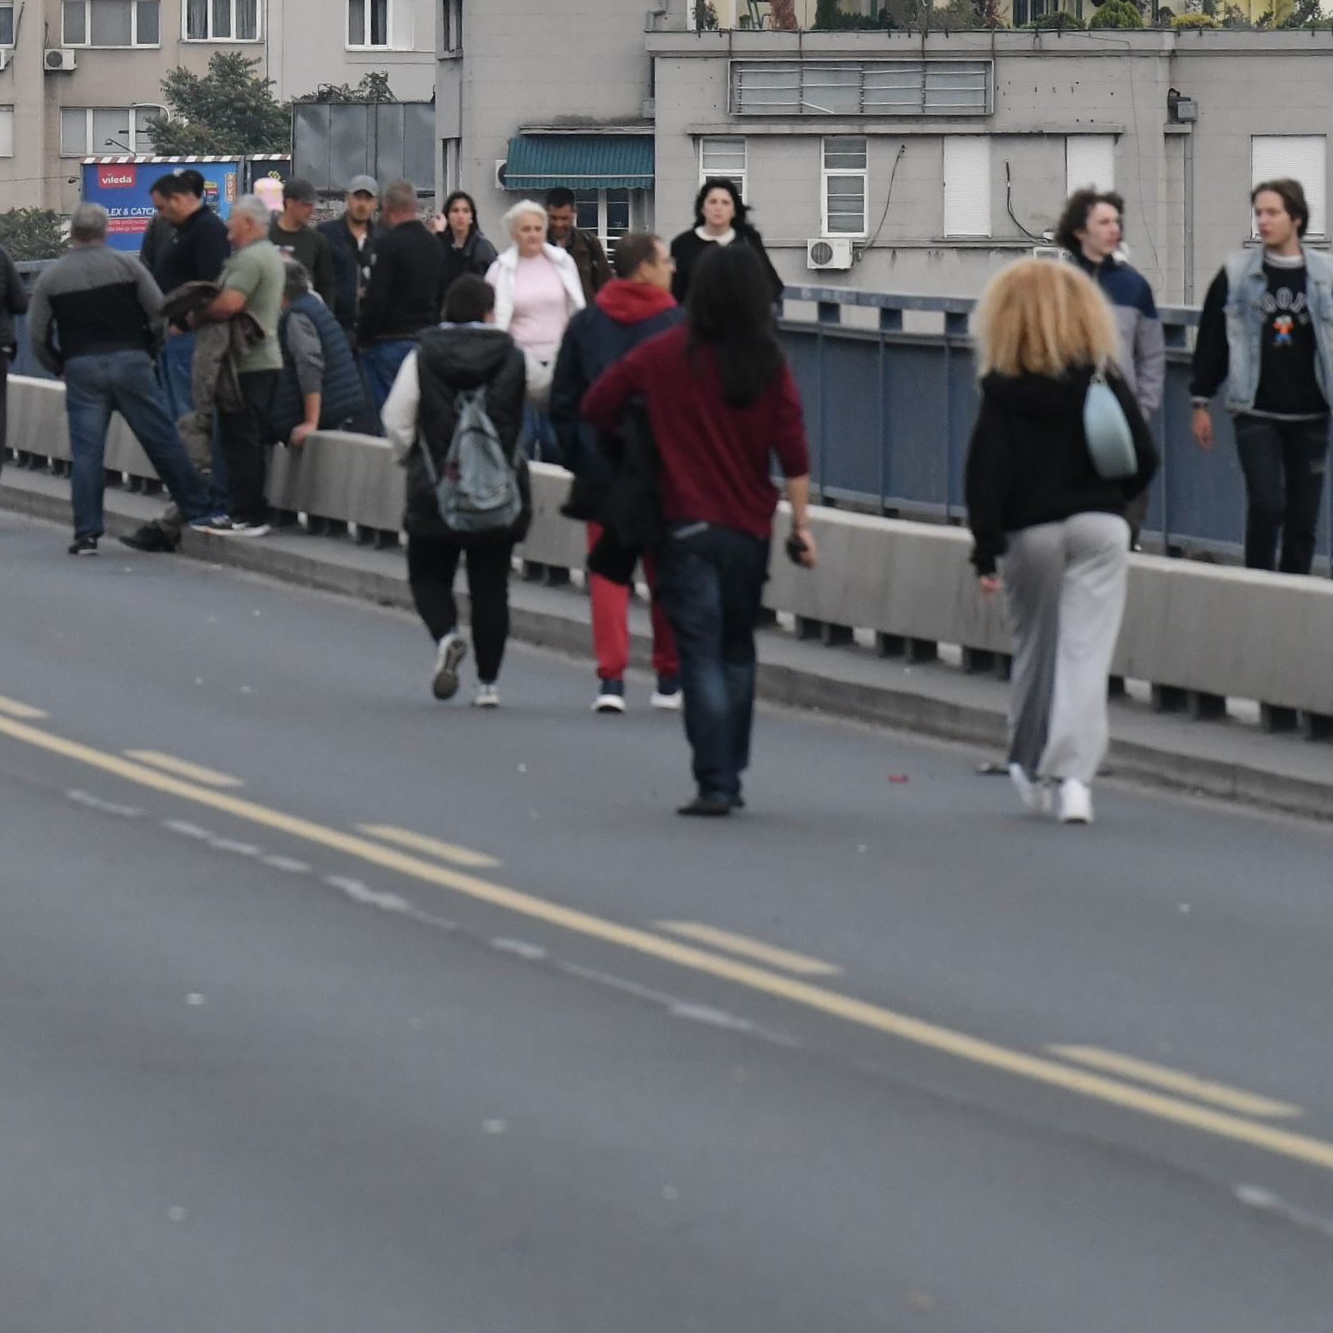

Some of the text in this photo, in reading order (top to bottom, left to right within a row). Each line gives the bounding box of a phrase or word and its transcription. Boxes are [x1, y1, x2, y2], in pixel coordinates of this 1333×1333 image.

[102, 173, 133, 184] vileda
[105, 208, 122, 216] LEX
[123, 207, 129, 216] &
